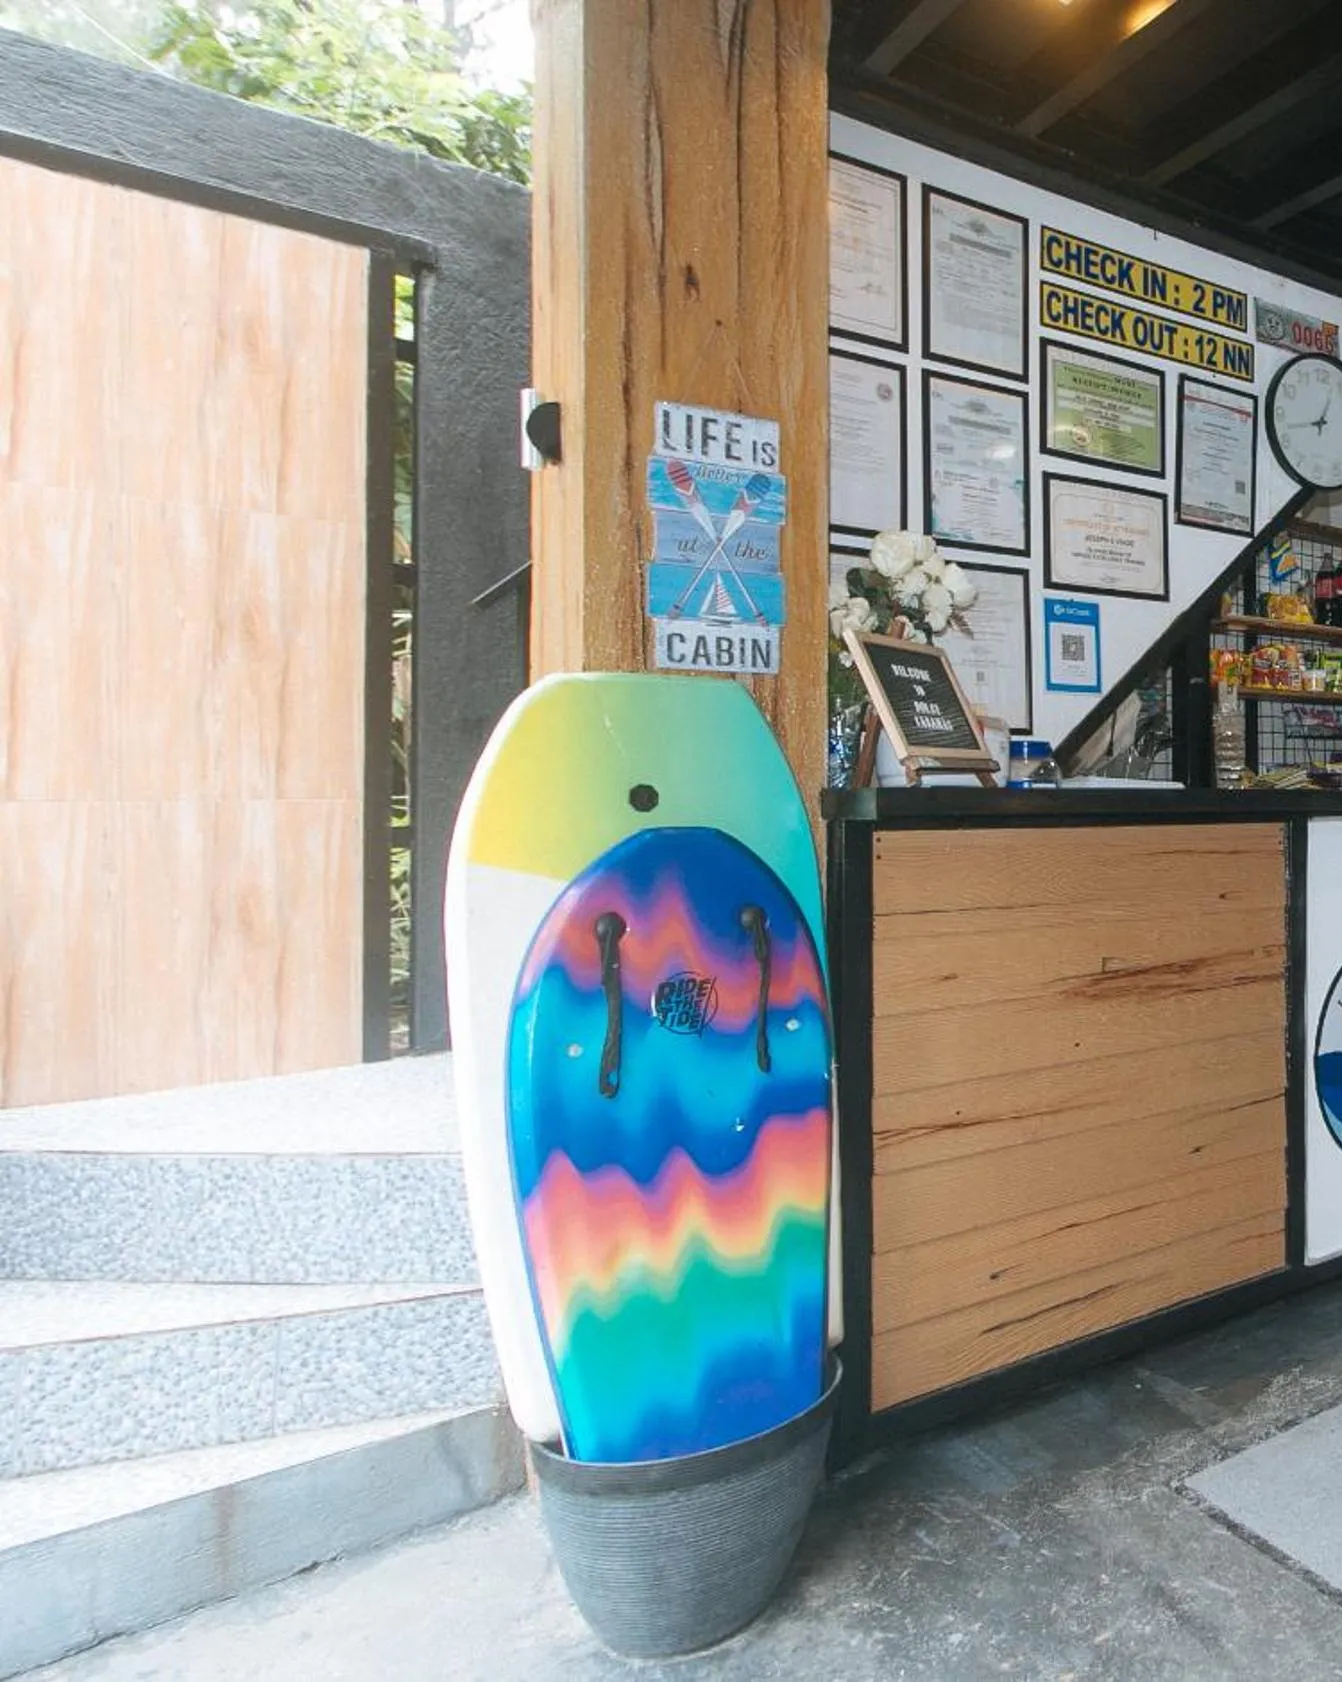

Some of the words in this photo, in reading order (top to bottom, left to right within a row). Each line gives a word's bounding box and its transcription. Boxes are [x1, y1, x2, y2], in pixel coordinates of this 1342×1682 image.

[1046, 235, 1135, 292] CHECK
[1143, 267, 1168, 302] IN
[1192, 284, 1207, 314] 2
[1213, 290, 1245, 326] PM
[1046, 291, 1127, 341] CHECK
[1133, 316, 1177, 355] OUT
[1195, 335, 1217, 367] 12
[1223, 344, 1250, 376] NN
[662, 410, 742, 461] LIFE
[752, 440, 776, 466] IS
[678, 537, 699, 553] at
[734, 537, 770, 559] the
[666, 632, 771, 669] CABIN
[655, 978, 711, 1004] RIDE
[669, 996, 703, 1013] THE
[659, 1007, 702, 1030] TIDE
